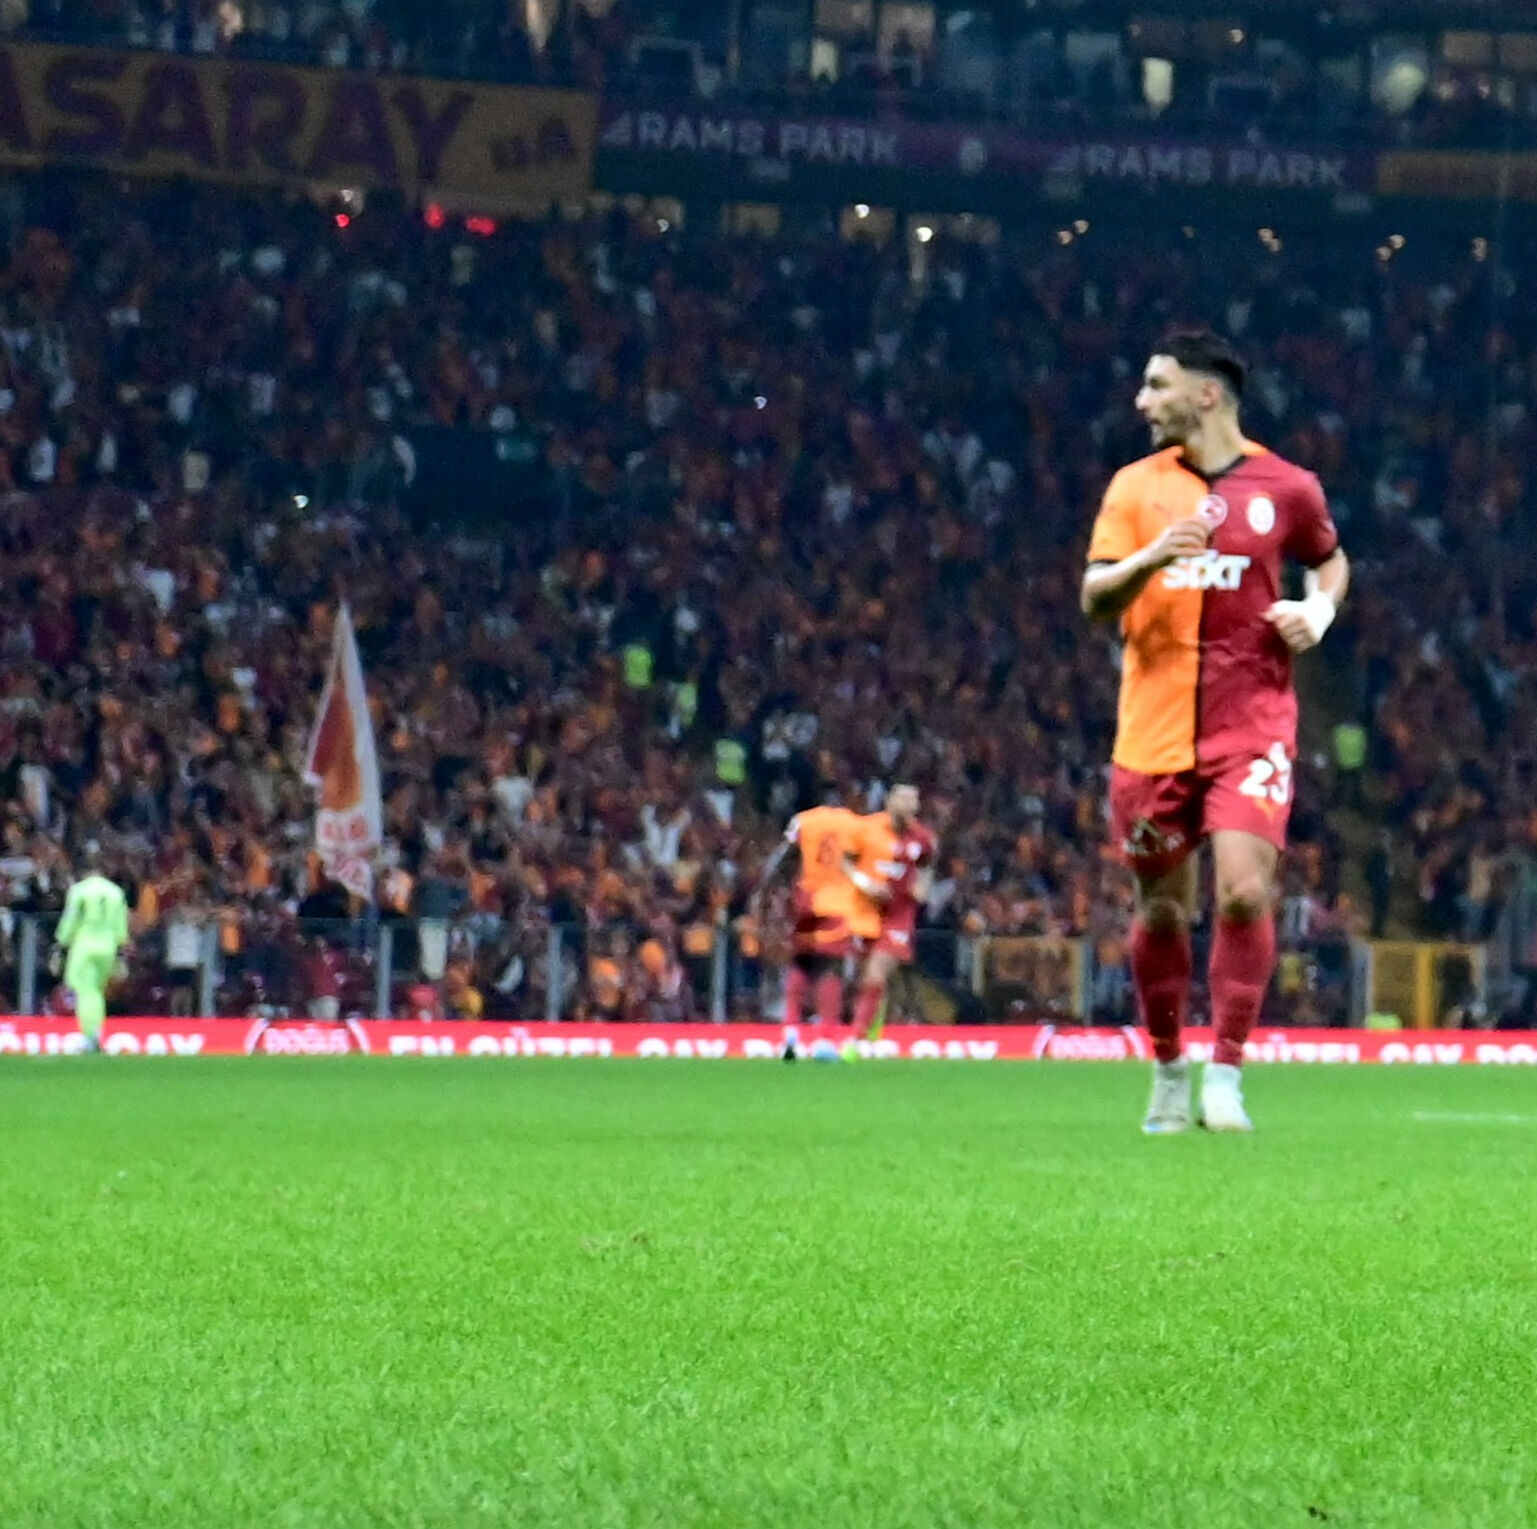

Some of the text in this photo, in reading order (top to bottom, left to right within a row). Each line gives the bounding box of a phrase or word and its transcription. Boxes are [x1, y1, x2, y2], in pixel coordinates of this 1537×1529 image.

[640, 113, 898, 166] RAMS PARK
[1086, 144, 1344, 186] RAMS PARK
